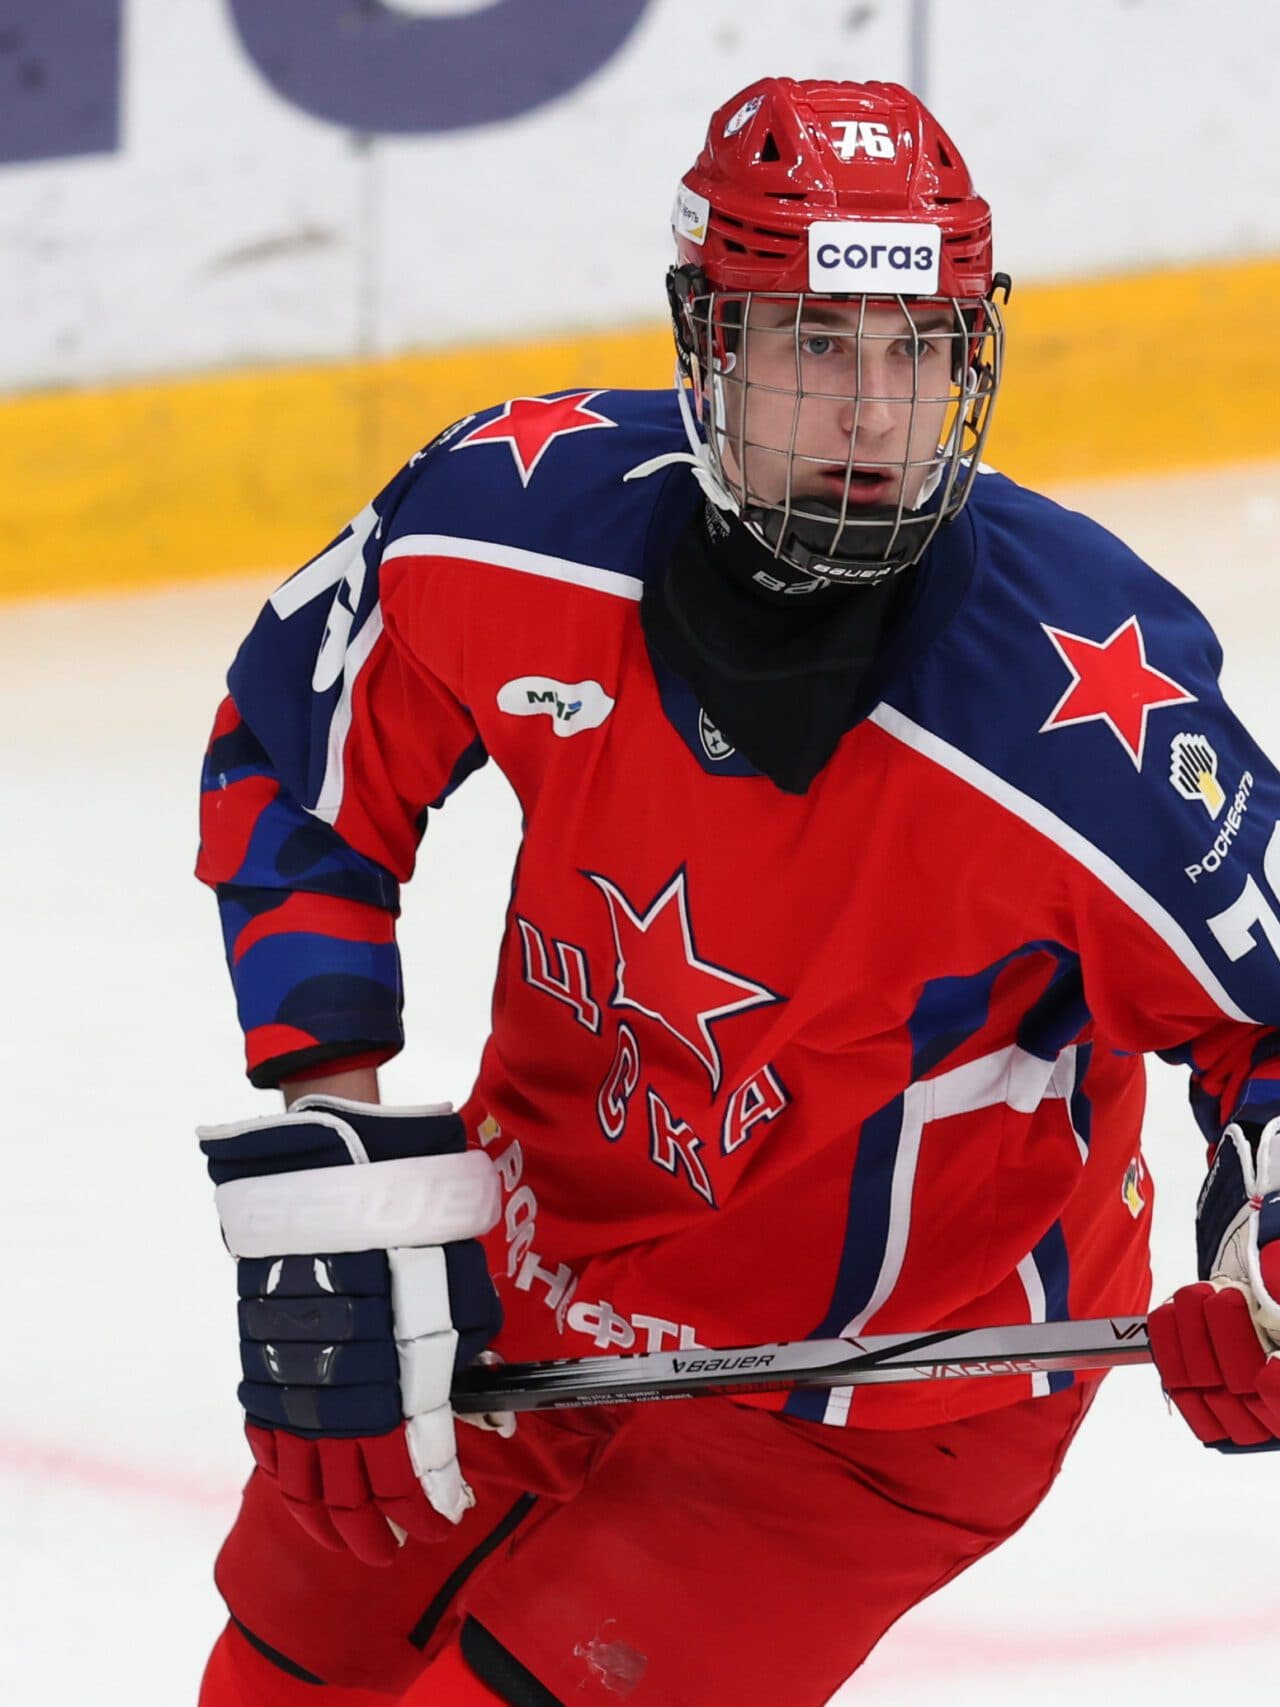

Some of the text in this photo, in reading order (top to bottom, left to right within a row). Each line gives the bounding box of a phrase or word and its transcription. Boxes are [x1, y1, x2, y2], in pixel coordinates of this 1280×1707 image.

[830, 120, 896, 159] 76
[1184, 770, 1254, 884] РОСНЕФТЬ
[913, 1358, 1042, 1381] VAPOR
